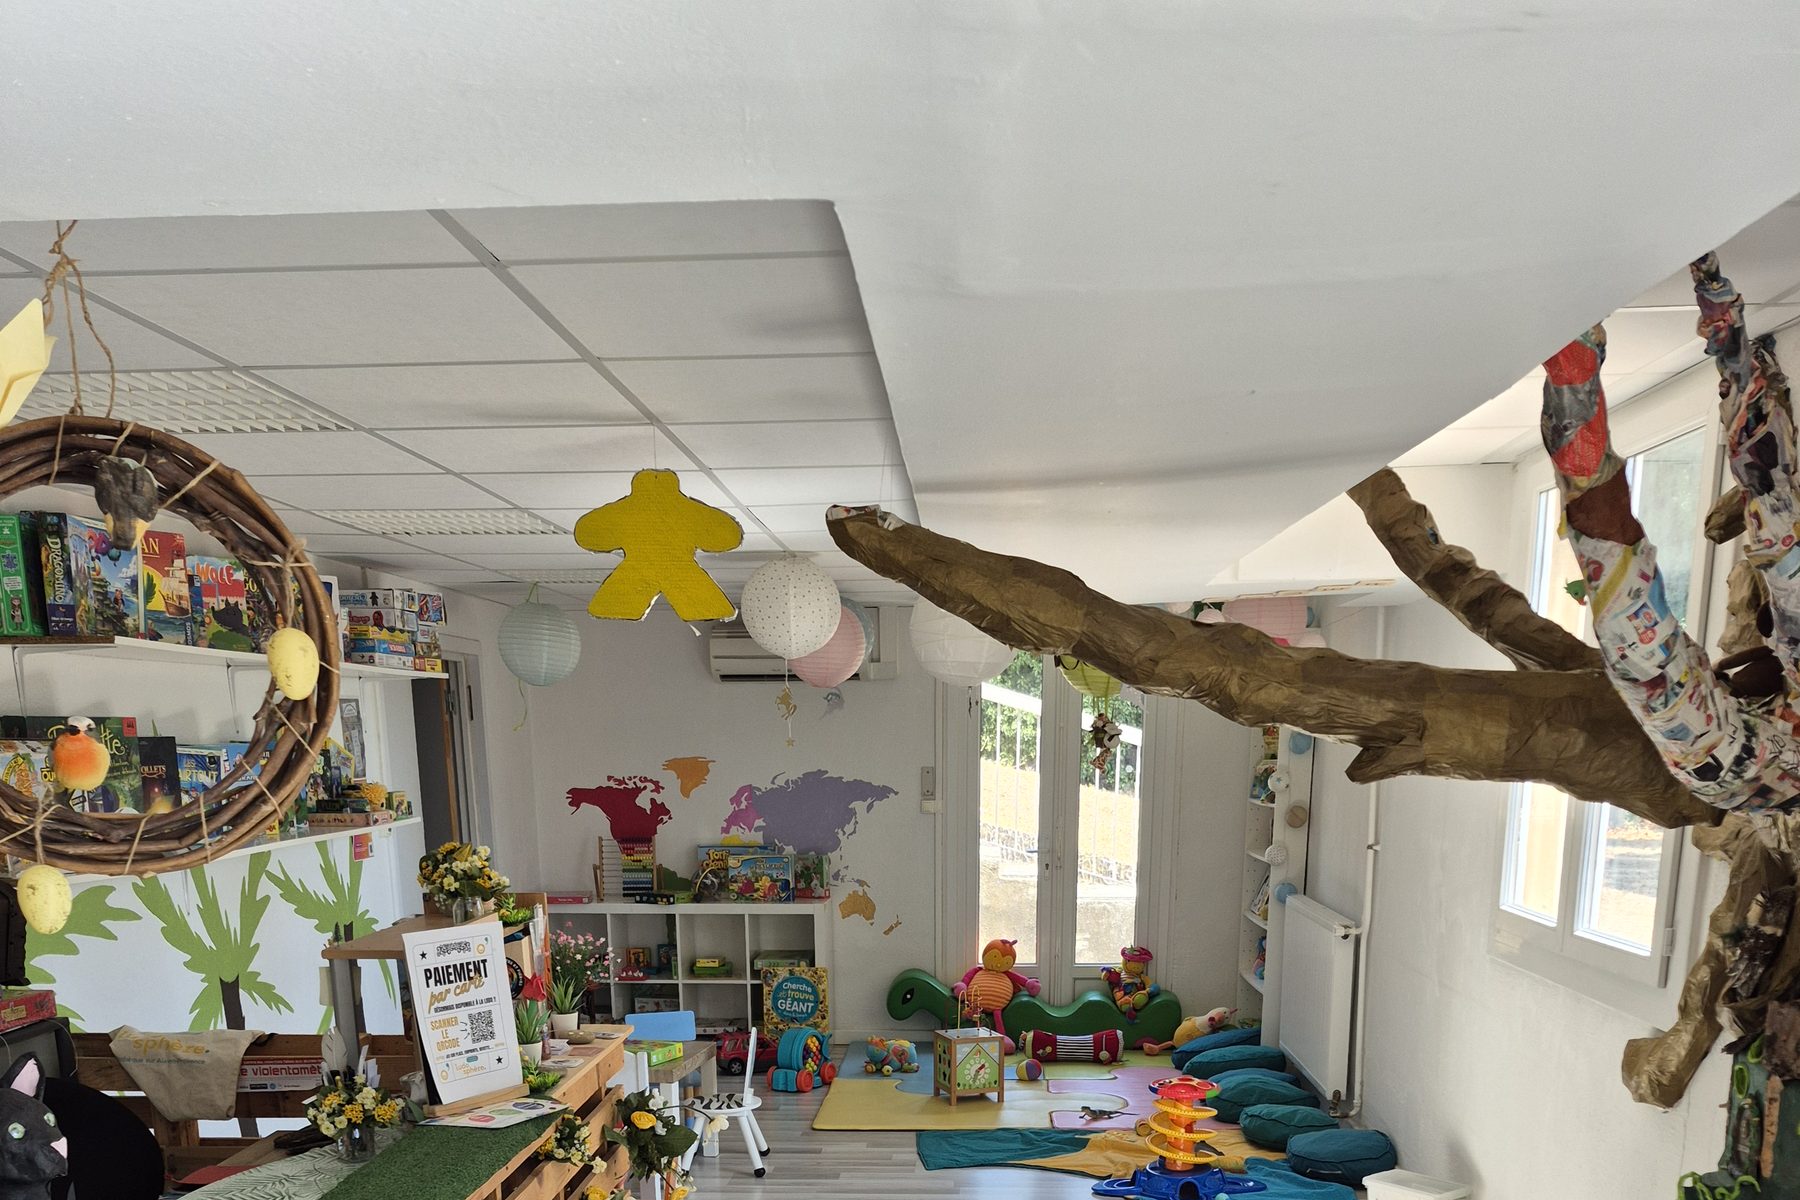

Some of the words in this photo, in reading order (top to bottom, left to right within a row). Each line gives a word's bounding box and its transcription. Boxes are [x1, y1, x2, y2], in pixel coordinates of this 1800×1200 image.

[47, 536, 65, 605] DRAGOMINO
[423, 958, 489, 989] PAIEMENT
[427, 988, 451, 1015] par
[454, 973, 485, 998] carte
[782, 981, 813, 993] Cherche
[787, 988, 815, 1001] trouve
[777, 997, 815, 1014] GÉANT
[430, 1015, 459, 1031] SCANNER
[441, 1028, 449, 1039] LE
[436, 1037, 461, 1052] QRCODE
[251, 1064, 323, 1077] violentomèt
